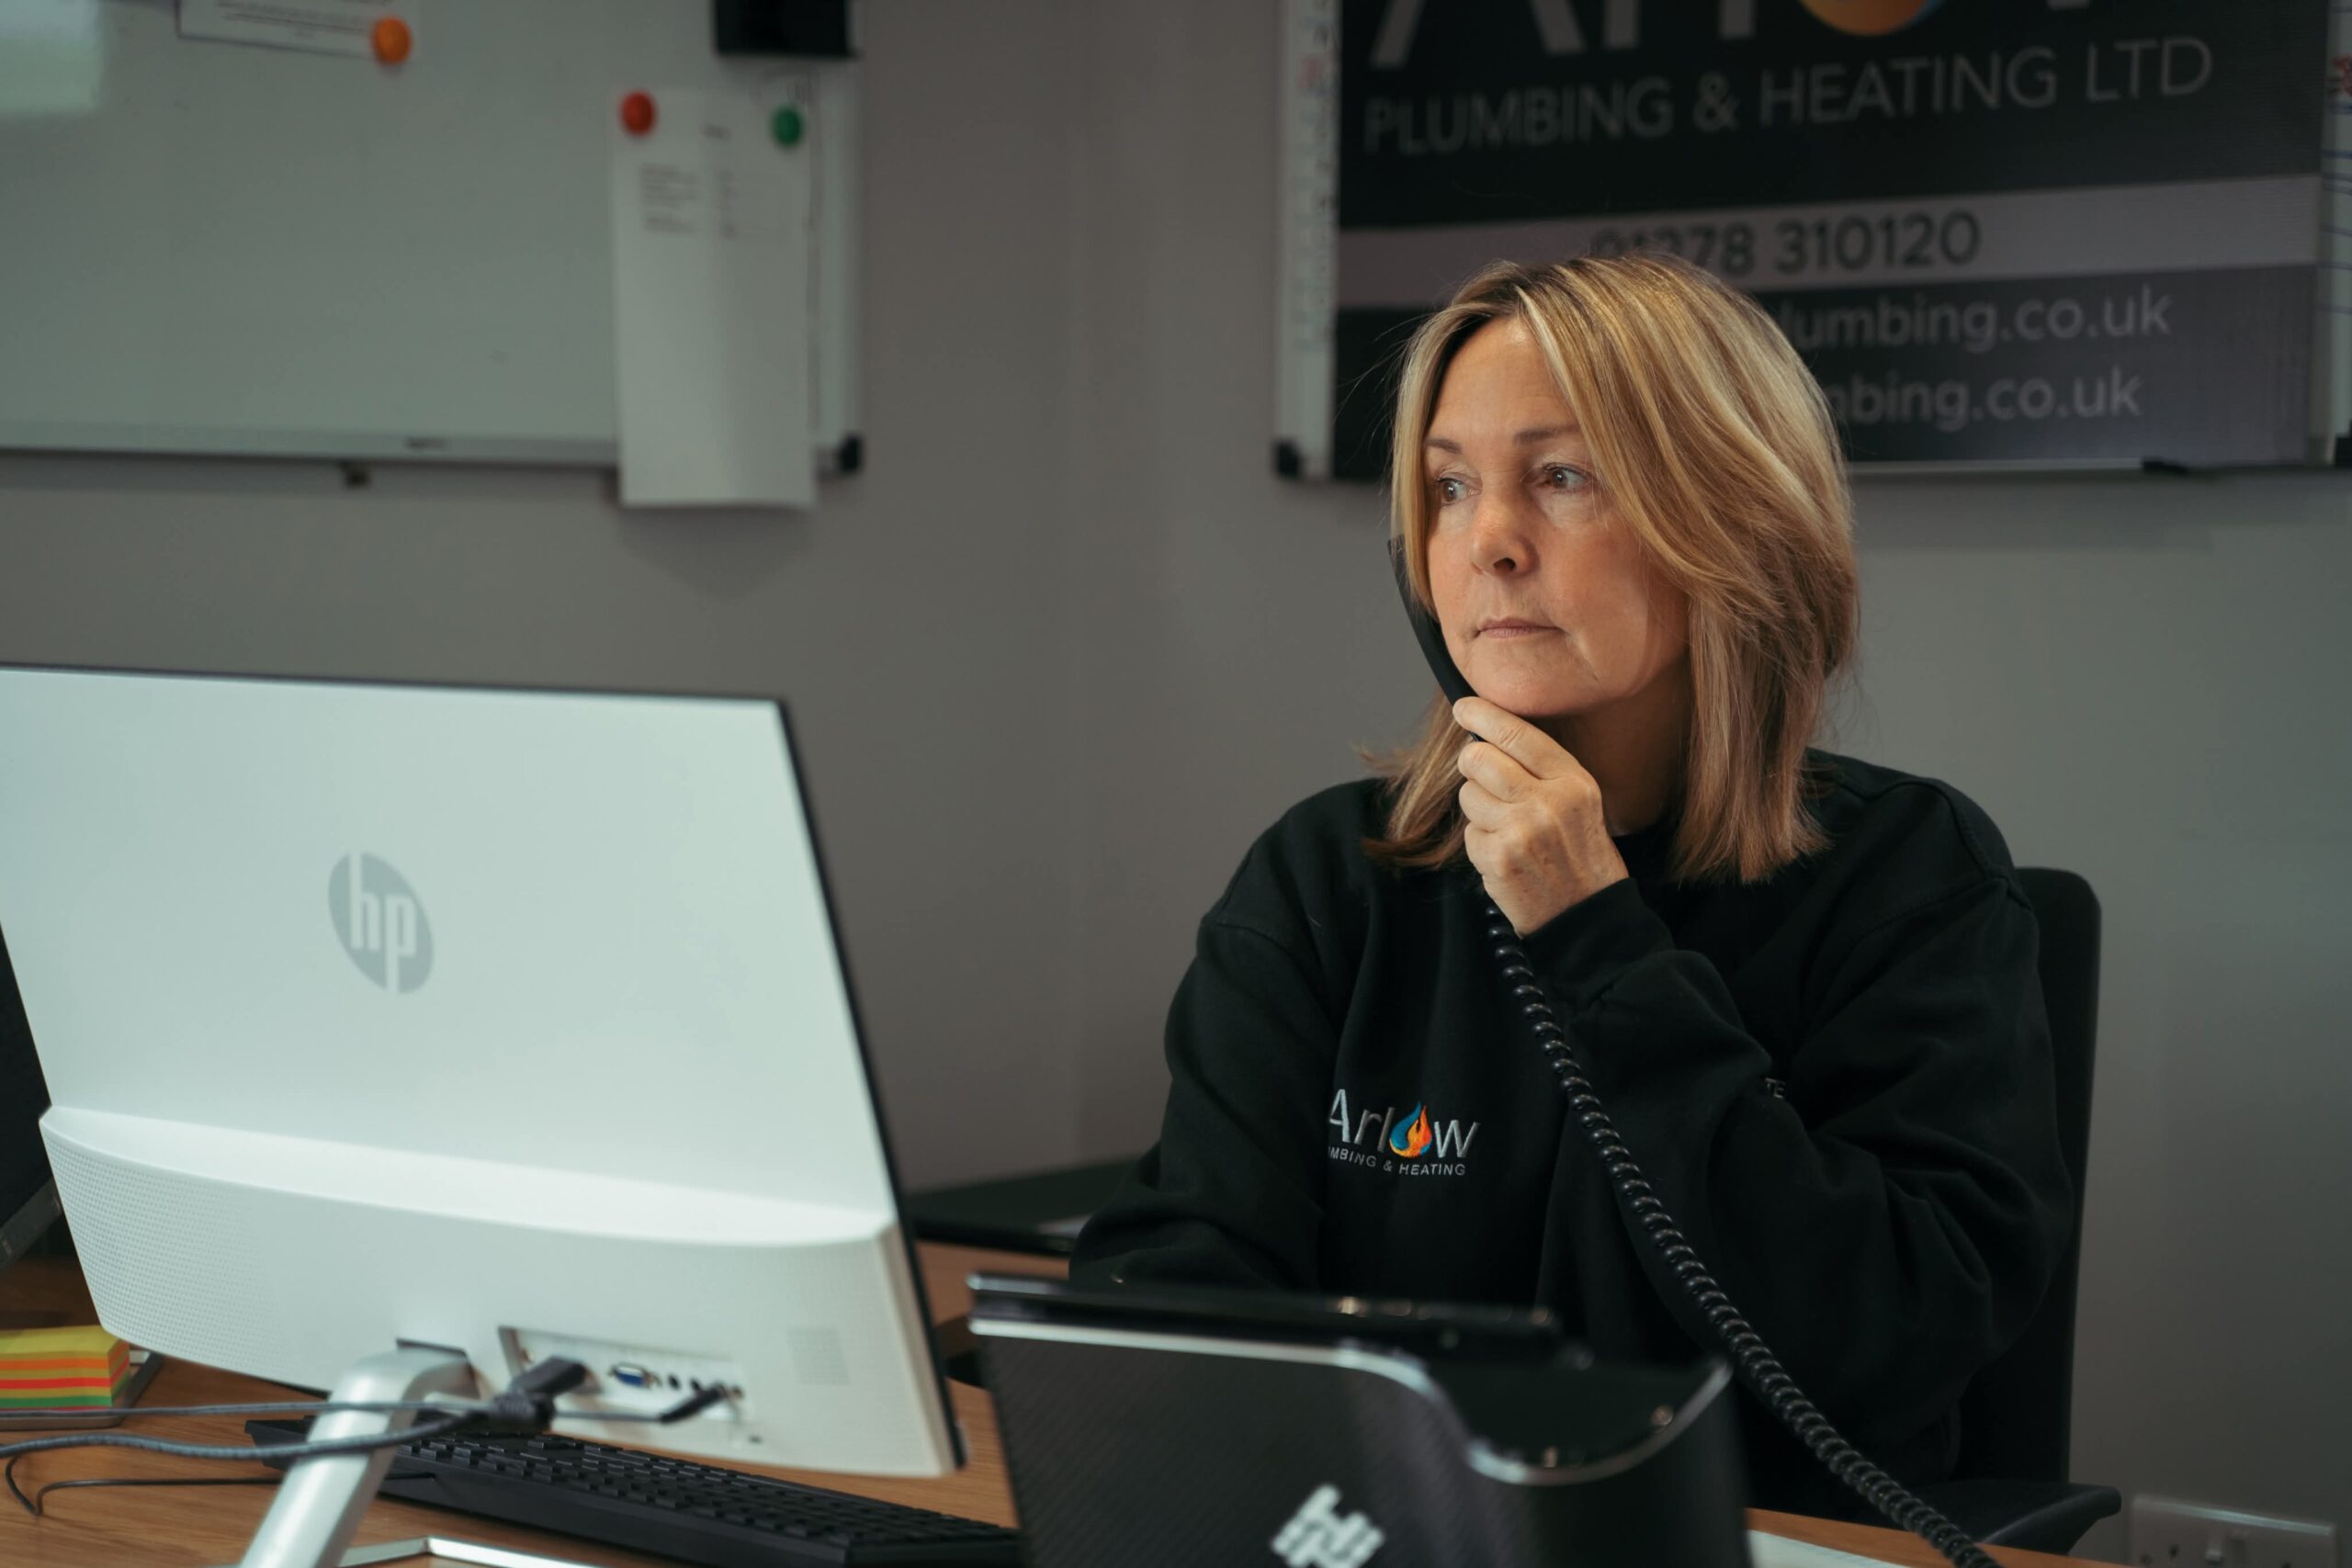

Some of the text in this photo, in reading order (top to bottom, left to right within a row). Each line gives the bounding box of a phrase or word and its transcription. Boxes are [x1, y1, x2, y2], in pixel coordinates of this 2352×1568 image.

[1364, 37, 2214, 154] PLUMBING & HEATING LTD
[1775, 210, 1982, 275] 310120
[1779, 283, 2174, 354] lumbing.co.uk
[349, 852, 416, 993] hp
[1329, 1146, 1466, 1176] MBING & HEATING
